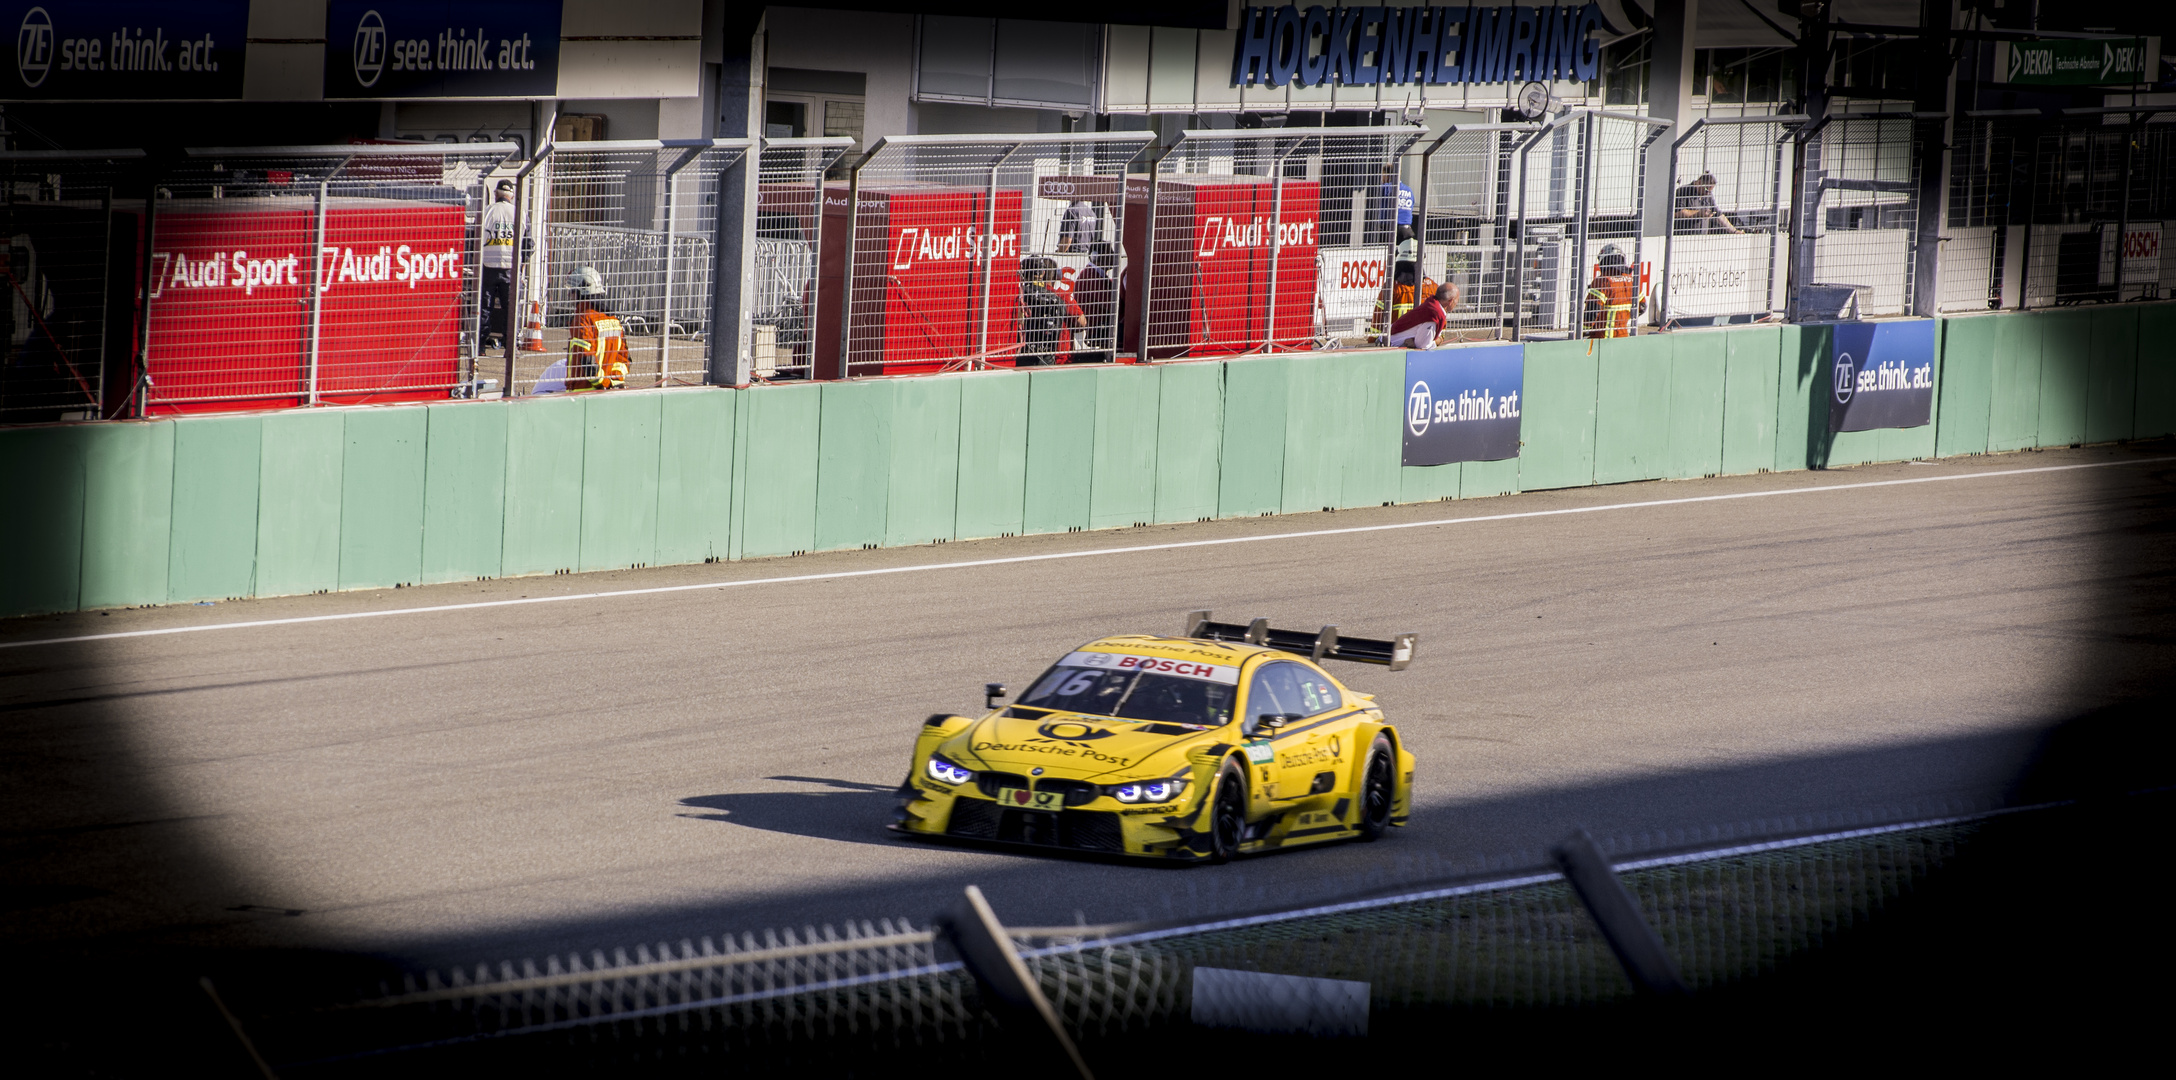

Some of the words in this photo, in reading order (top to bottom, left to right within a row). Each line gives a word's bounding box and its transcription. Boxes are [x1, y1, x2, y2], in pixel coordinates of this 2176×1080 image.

[61, 38, 104, 71] see.
[110, 27, 172, 71] think.
[178, 33, 218, 72] act.
[392, 39, 433, 70] see.
[437, 28, 493, 70] think.
[498, 32, 534, 70] act.
[1234, 3, 1601, 87] HOCKENHEIMRING
[2023, 49, 2053, 75] DEKRA
[825, 196, 851, 206] Aud
[918, 227, 961, 260] Audi
[1222, 216, 1262, 247] Audi
[170, 251, 226, 288] Audi
[232, 250, 298, 295] Sport
[338, 245, 391, 282] Audi
[396, 244, 459, 289] Sport
[1856, 369, 1877, 393] see.
[1878, 360, 1911, 391] think.
[1914, 362, 1933, 389] act.
[1434, 399, 1457, 424] see.
[1459, 388, 1496, 421] think.
[1499, 389, 1520, 418] act.
[1093, 641, 1187, 653] Deutsche
[1189, 648, 1234, 662] Post
[1118, 656, 1215, 679] BOSCH
[1040, 669, 1105, 696] 16
[974, 741, 1077, 757] Deutsche
[1080, 748, 1132, 767] Post
